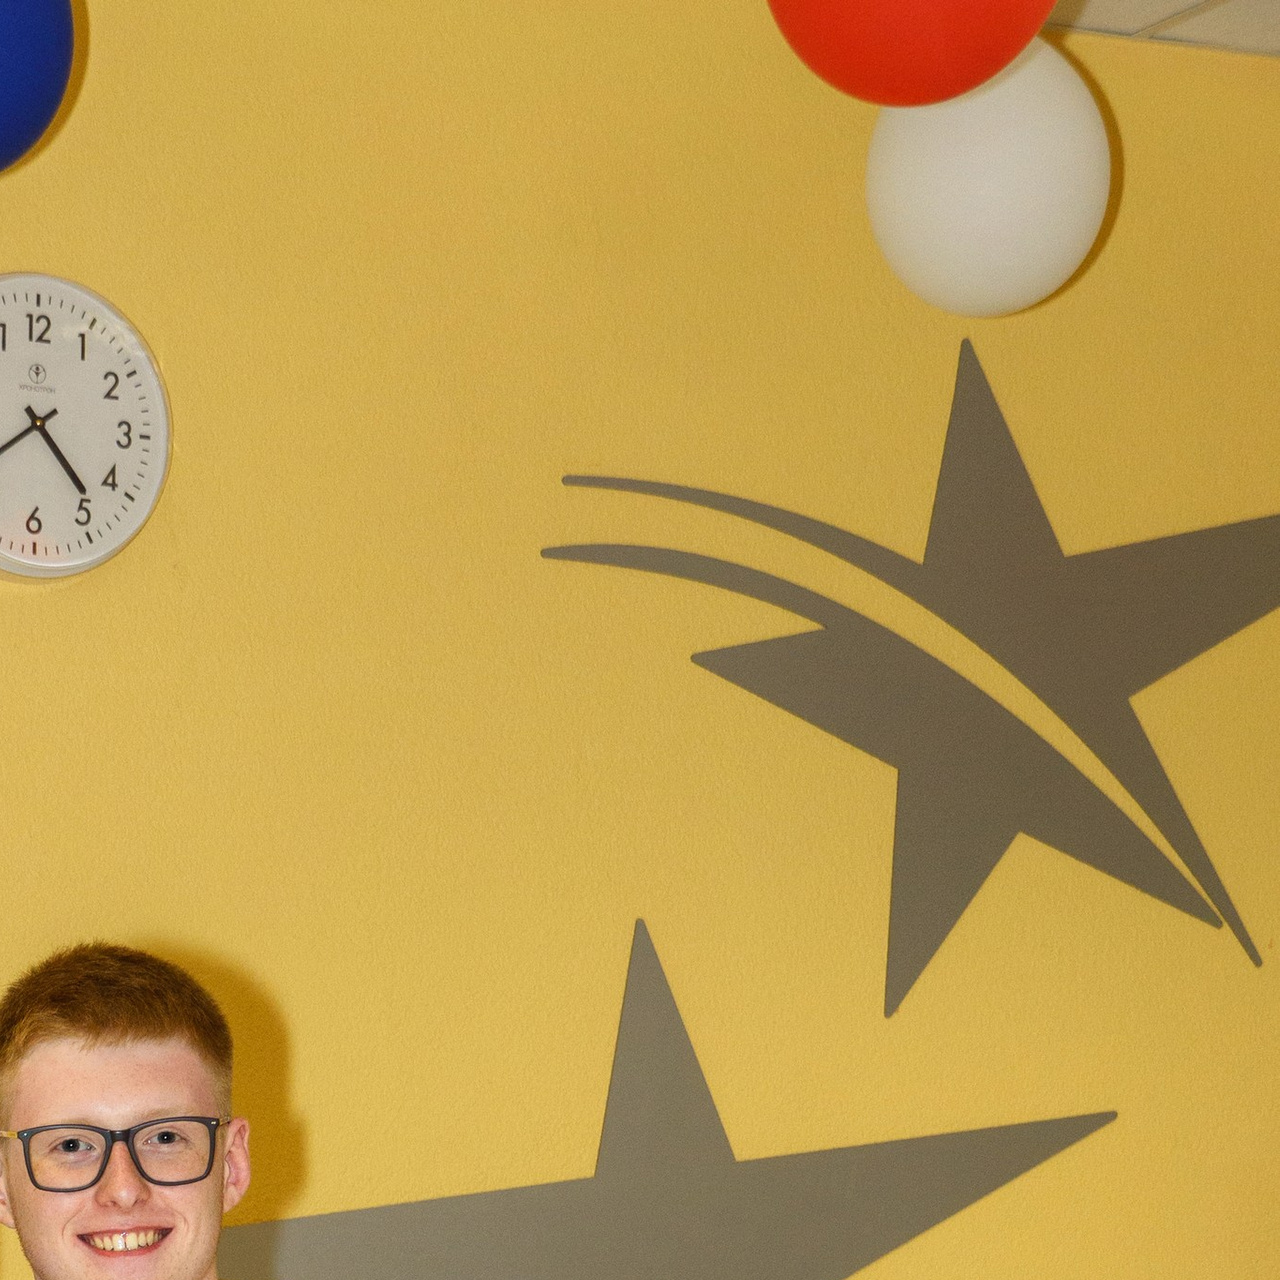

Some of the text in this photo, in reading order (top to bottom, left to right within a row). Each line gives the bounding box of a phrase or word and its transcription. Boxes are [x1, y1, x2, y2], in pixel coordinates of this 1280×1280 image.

[25, 314, 51, 344] 12
[78, 333, 86, 361] 1
[103, 372, 120, 400] 2
[116, 421, 132, 449] 3
[101, 464, 119, 491] 4
[26, 506, 42, 534] 6
[74, 498, 91, 526] 5
